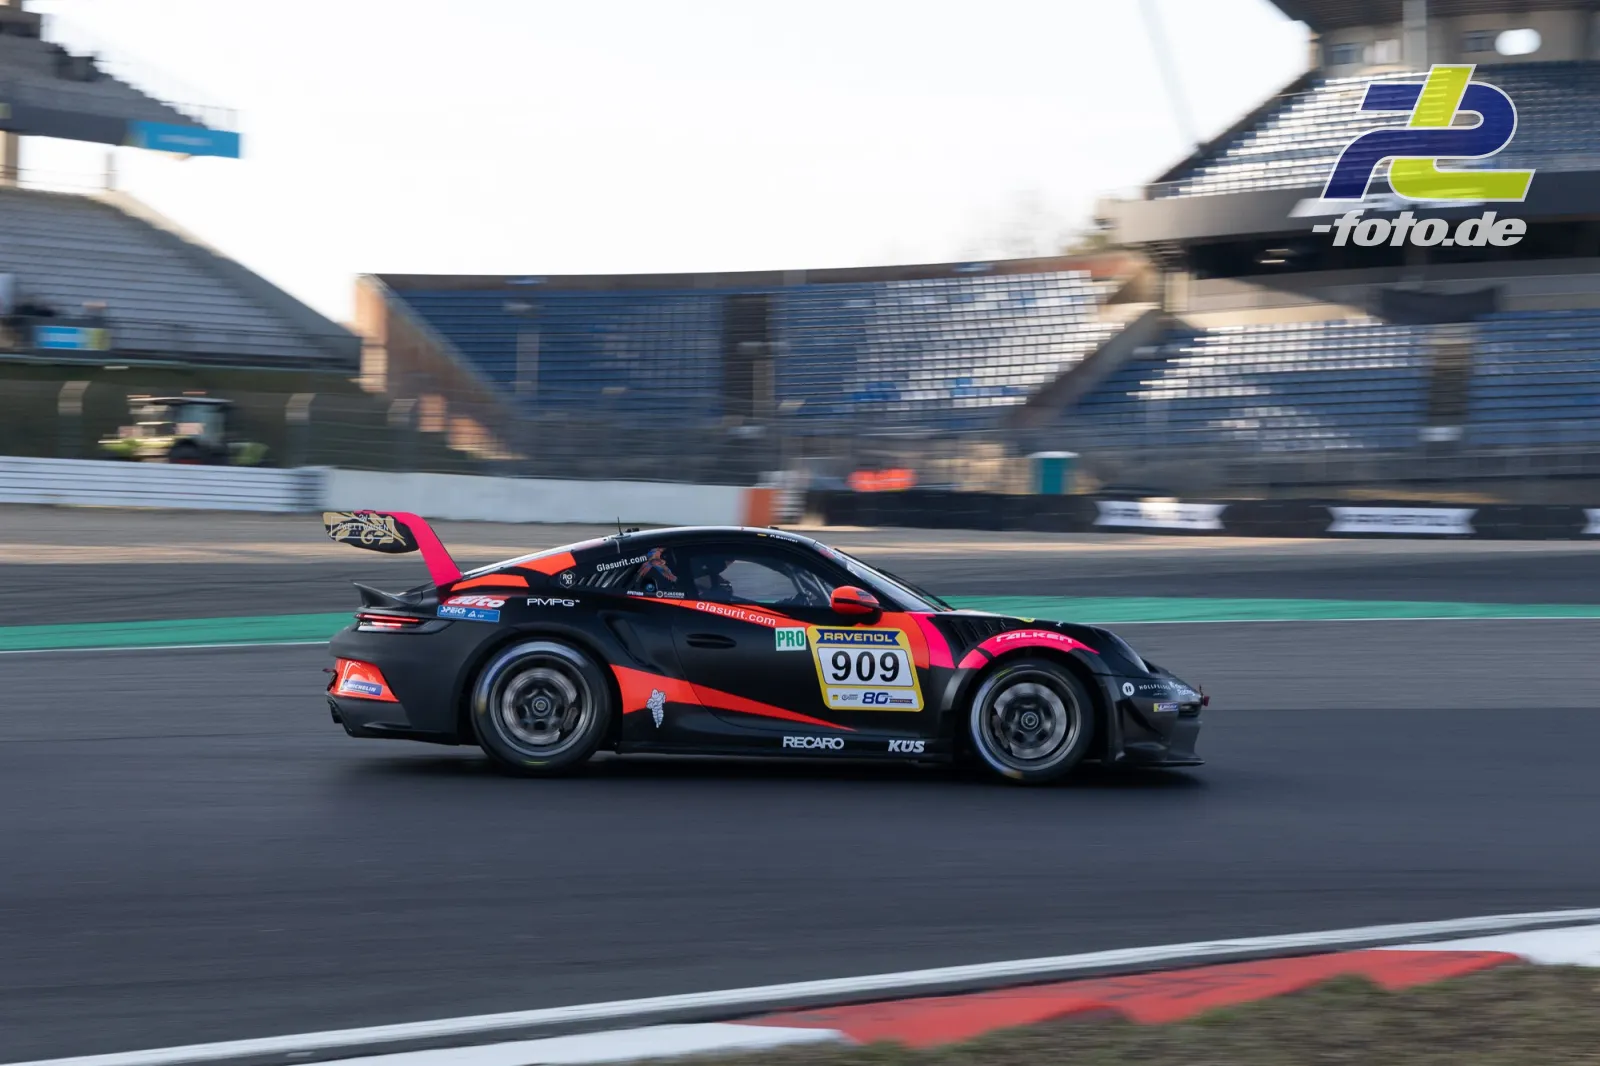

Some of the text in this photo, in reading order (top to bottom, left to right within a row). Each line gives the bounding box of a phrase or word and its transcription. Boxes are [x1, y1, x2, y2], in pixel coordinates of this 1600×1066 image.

[597, 555, 648, 572] Glasurit.com
[696, 602, 776, 626] Glasurit.com
[777, 630, 805, 647] PRO
[823, 632, 893, 643] RAVENOL
[996, 632, 1073, 644] FALKEN
[831, 650, 900, 682] 909
[782, 736, 844, 749] RECARO
[888, 739, 926, 753] KÜS
